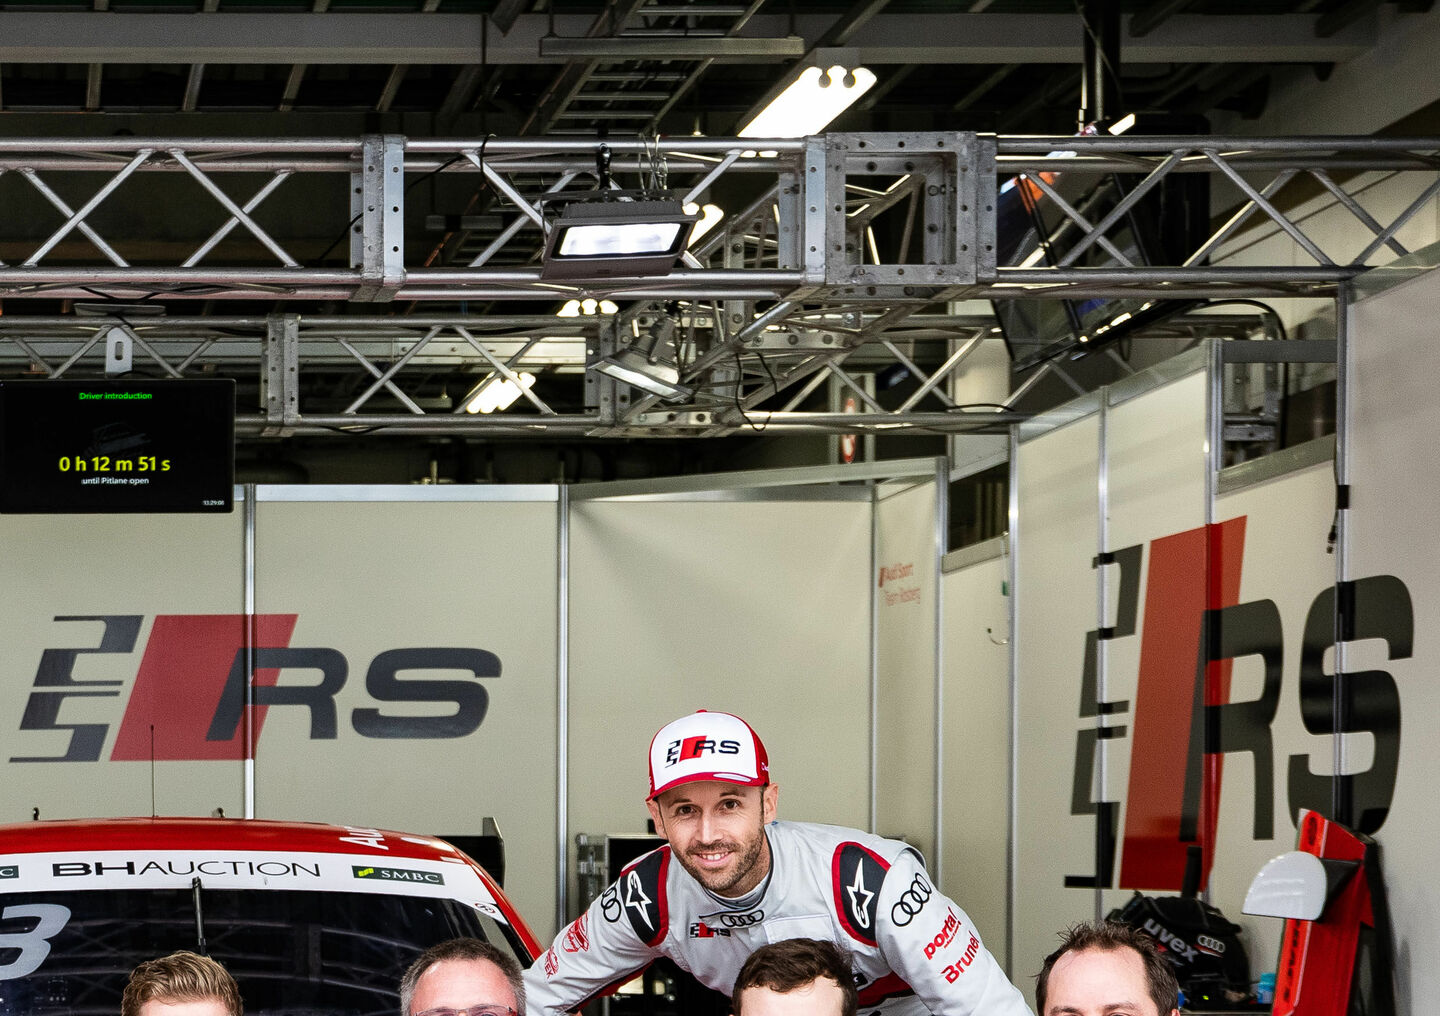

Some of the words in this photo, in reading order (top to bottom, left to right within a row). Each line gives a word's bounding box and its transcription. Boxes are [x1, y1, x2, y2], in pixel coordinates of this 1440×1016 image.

[78, 391, 103, 401] Driver
[104, 391, 153, 401] introduction
[59, 456, 71, 472] 0
[75, 456, 87, 472] h
[91, 456, 111, 472] 12
[115, 459, 133, 472] m
[138, 456, 157, 472] 51
[161, 459, 171, 472] s
[81, 477, 100, 485] until
[101, 477, 128, 485] Pitlane
[129, 478, 150, 486] open
[205, 647, 503, 741] RS
[1179, 574, 1415, 843] RS
[692, 740, 741, 756] RS
[381, 869, 441, 884] SMBC
[923, 905, 958, 961] portal
[1143, 918, 1200, 963] uvex
[940, 930, 980, 984] Brunel
